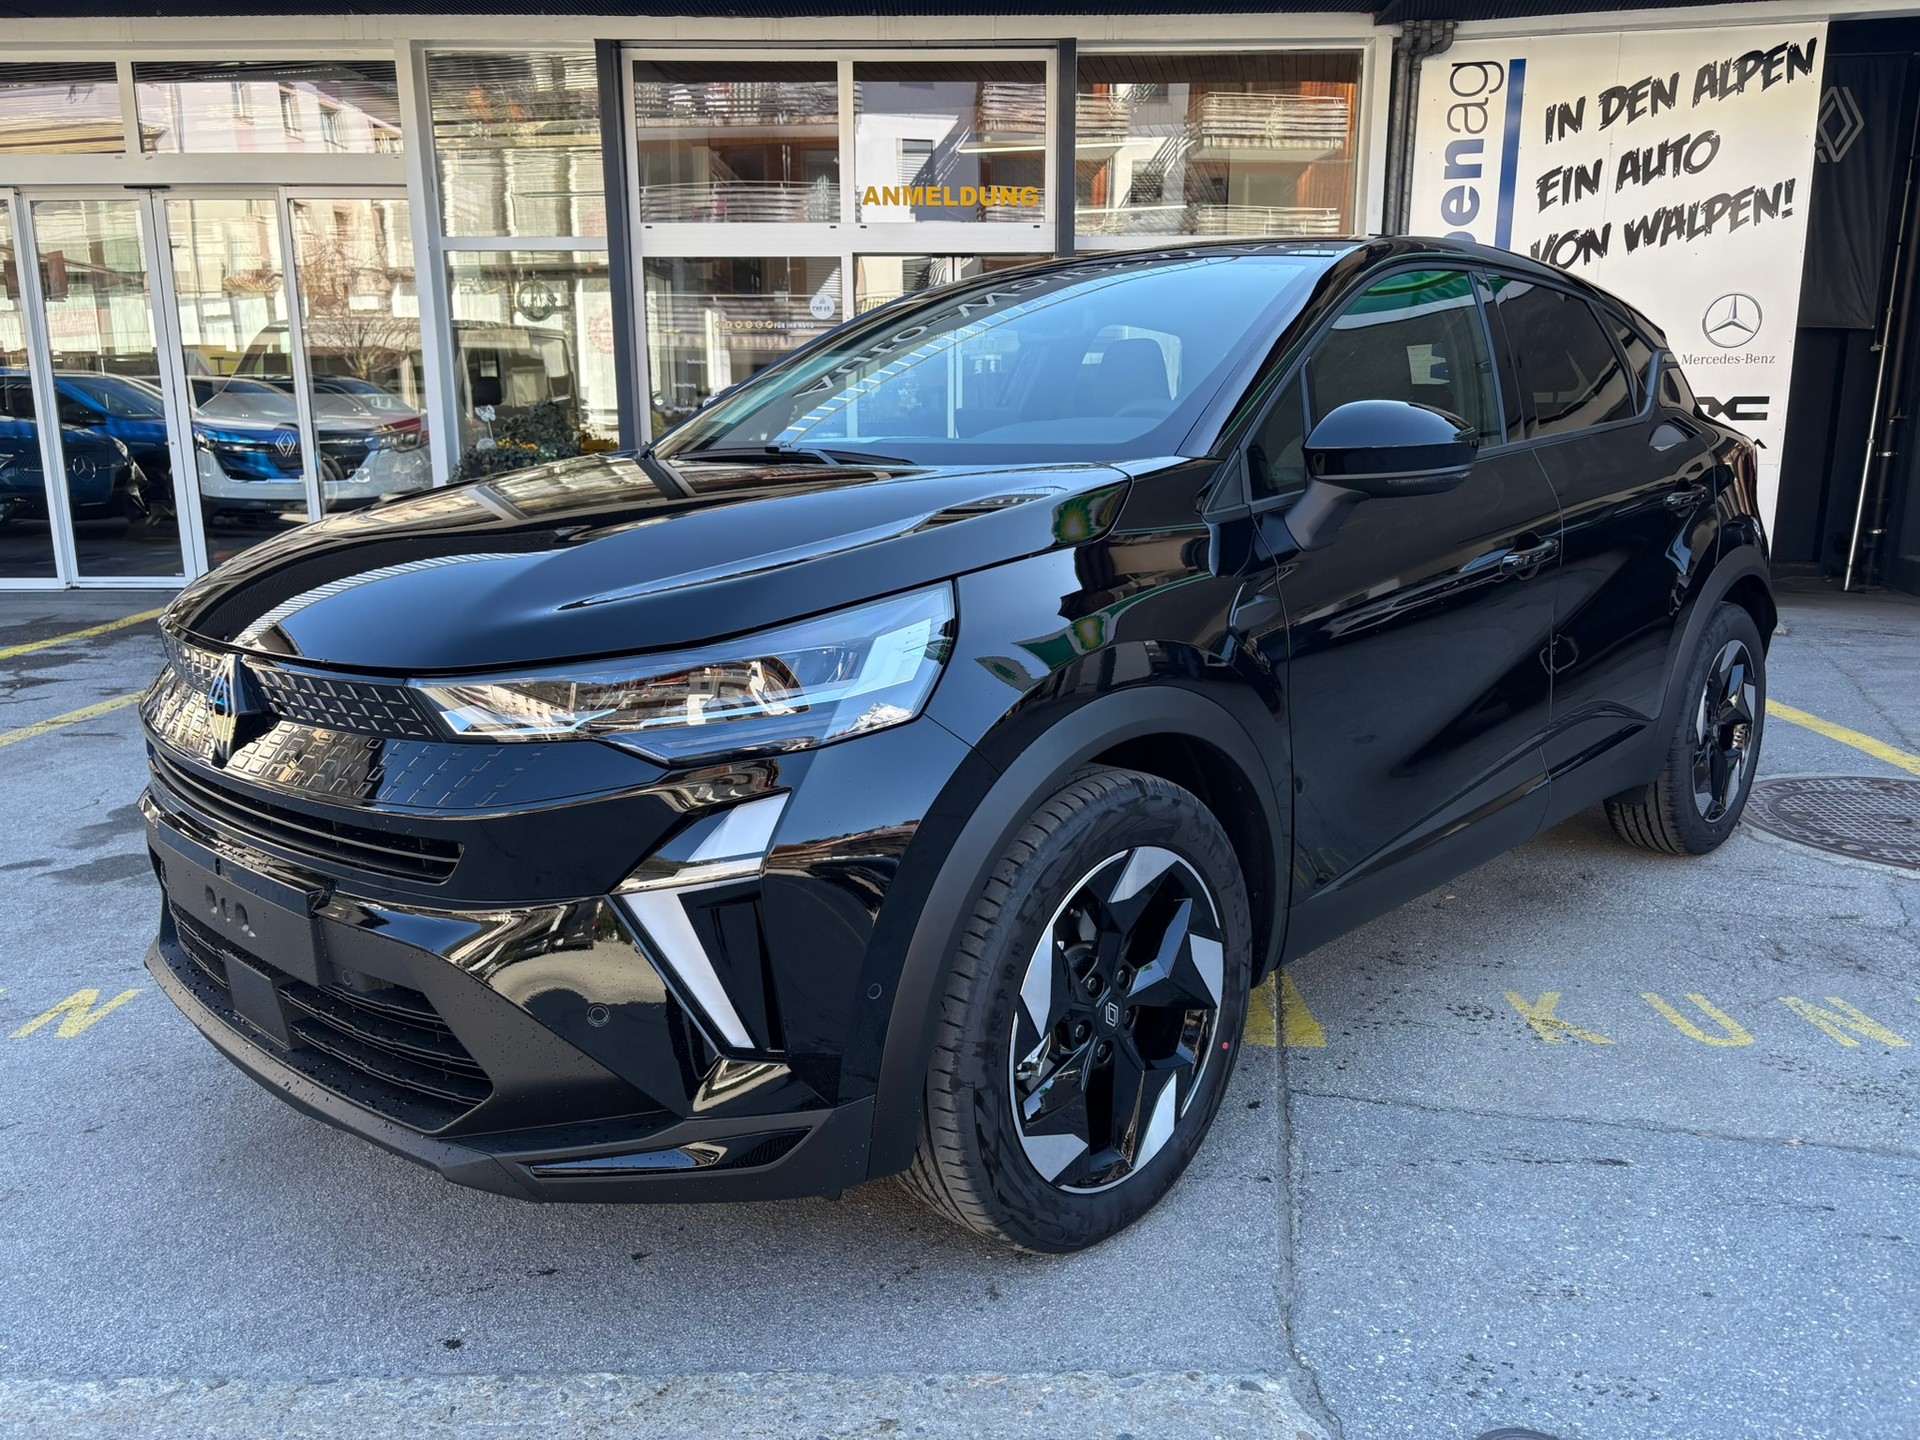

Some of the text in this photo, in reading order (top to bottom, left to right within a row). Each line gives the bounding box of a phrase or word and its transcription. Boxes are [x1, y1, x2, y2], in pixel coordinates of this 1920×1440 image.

[1546, 37, 1817, 145] IN DEN ALPEN
[1440, 61, 1505, 244] enag
[1536, 129, 1721, 213] EIN AUTO
[862, 185, 1040, 209] ANMELDUNG
[1530, 178, 1796, 269] VON WALPEN!
[1681, 353, 1776, 365] Mercedes-Benz
[1504, 991, 1920, 1048] KUN
